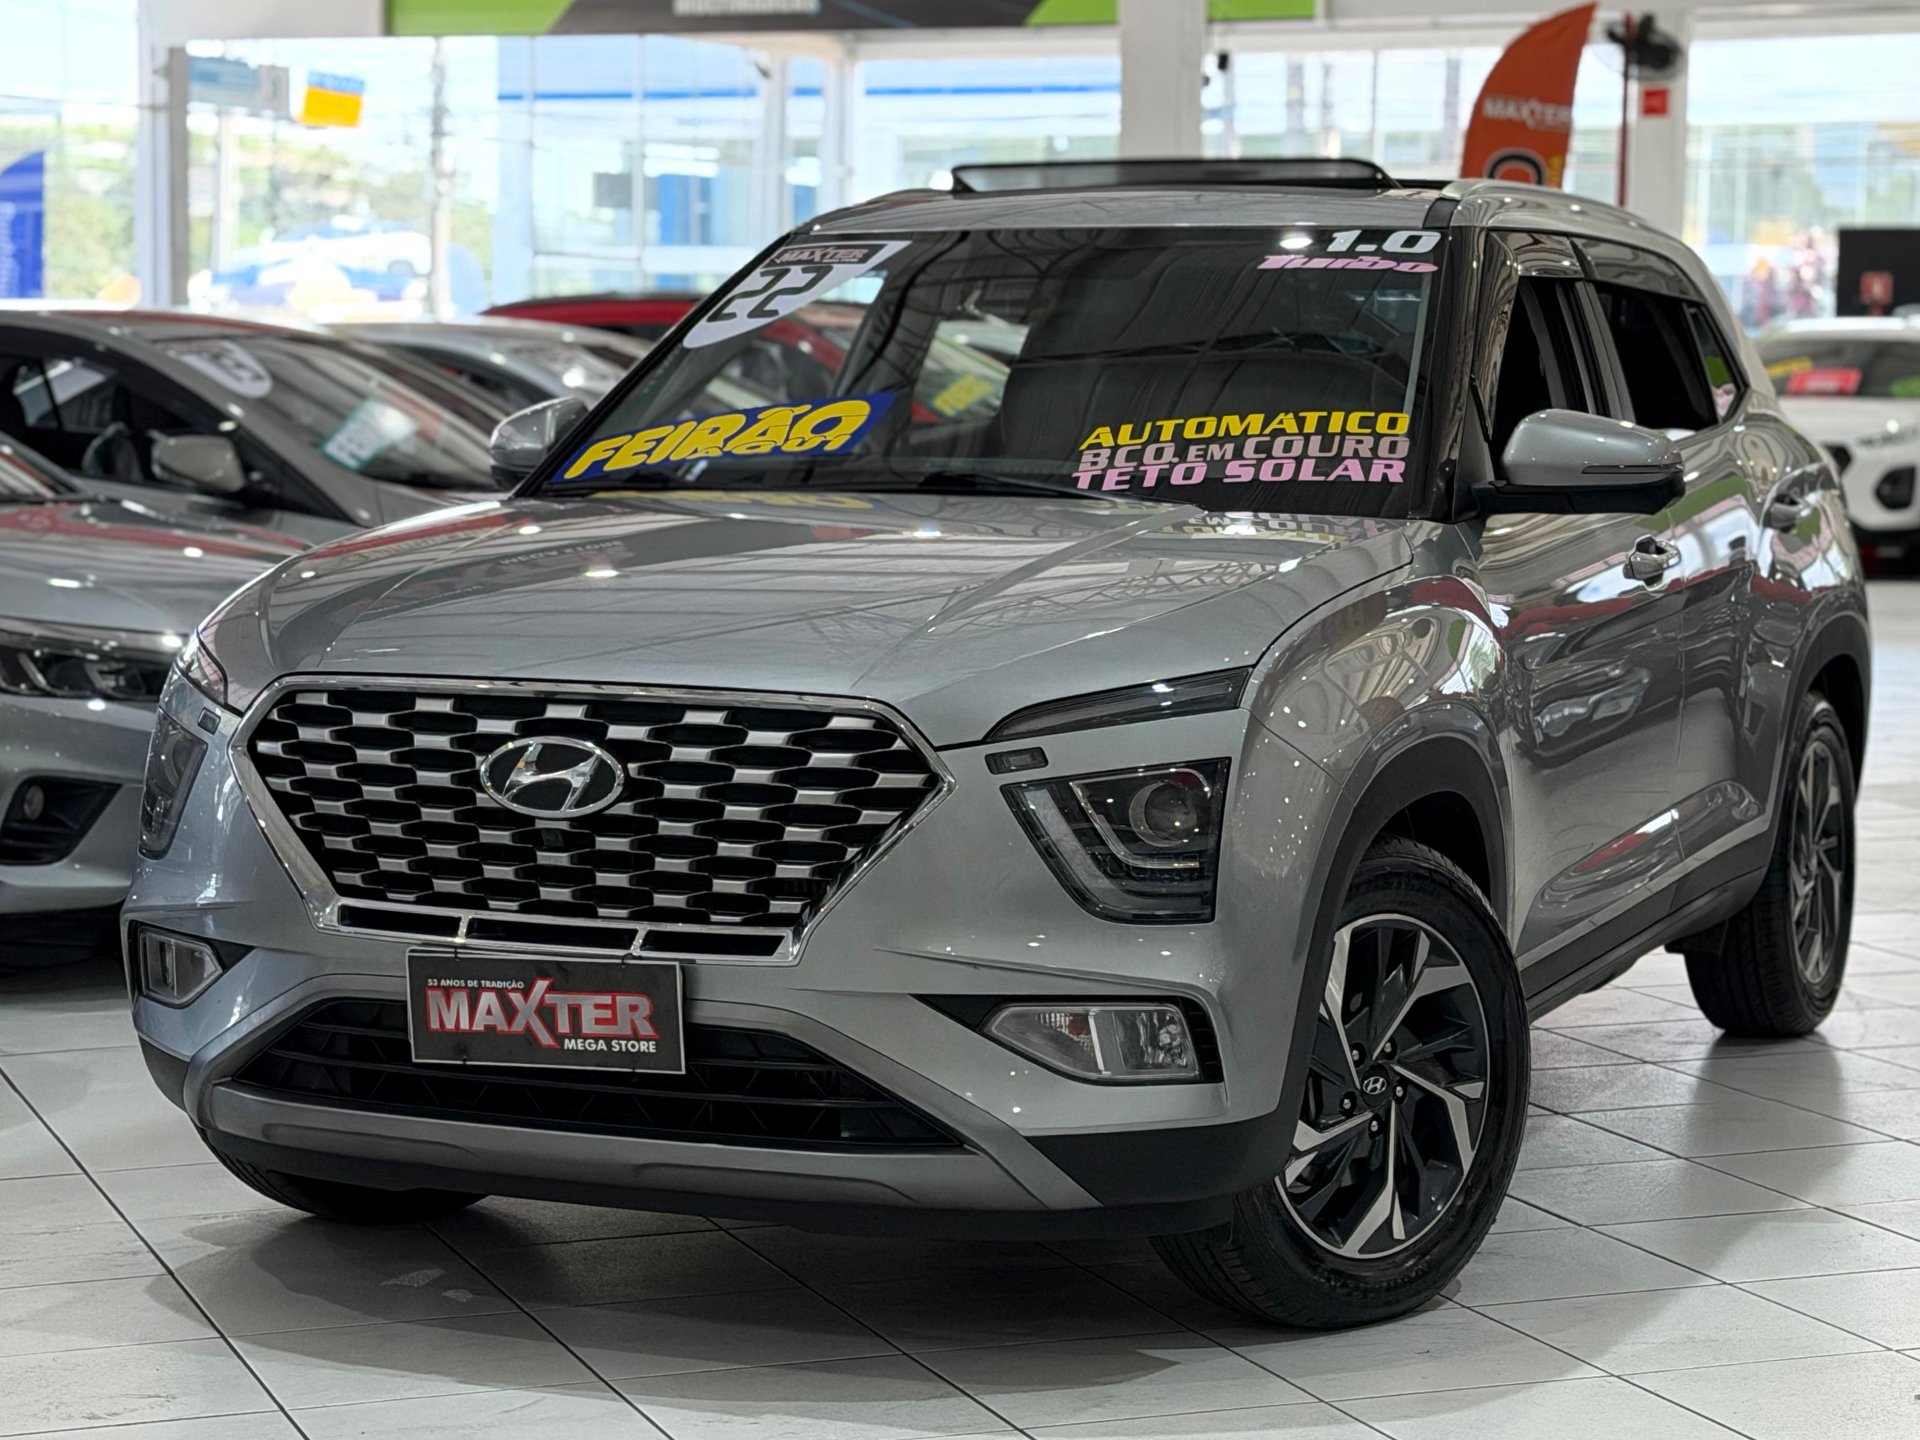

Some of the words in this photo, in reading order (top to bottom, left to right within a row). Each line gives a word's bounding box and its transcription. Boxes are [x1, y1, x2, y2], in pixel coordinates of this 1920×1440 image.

[1326, 229, 1441, 253] 1.0
[775, 247, 869, 264] MAXTER
[1257, 254, 1439, 273] Turbo
[706, 265, 833, 322] 22
[563, 400, 871, 480] FEIRÃO
[1186, 443, 1235, 463] EM
[1242, 435, 1410, 459] COURO
[1071, 462, 1208, 491] TETO
[1222, 459, 1406, 483] SOLAR
[440, 979, 465, 988] ANOS
[467, 980, 479, 988] DE
[481, 979, 525, 990] TRADIÇÃO
[426, 977, 660, 1049] MAXTER
[564, 1038, 608, 1051] MEGA
[611, 1040, 657, 1053] STORE
